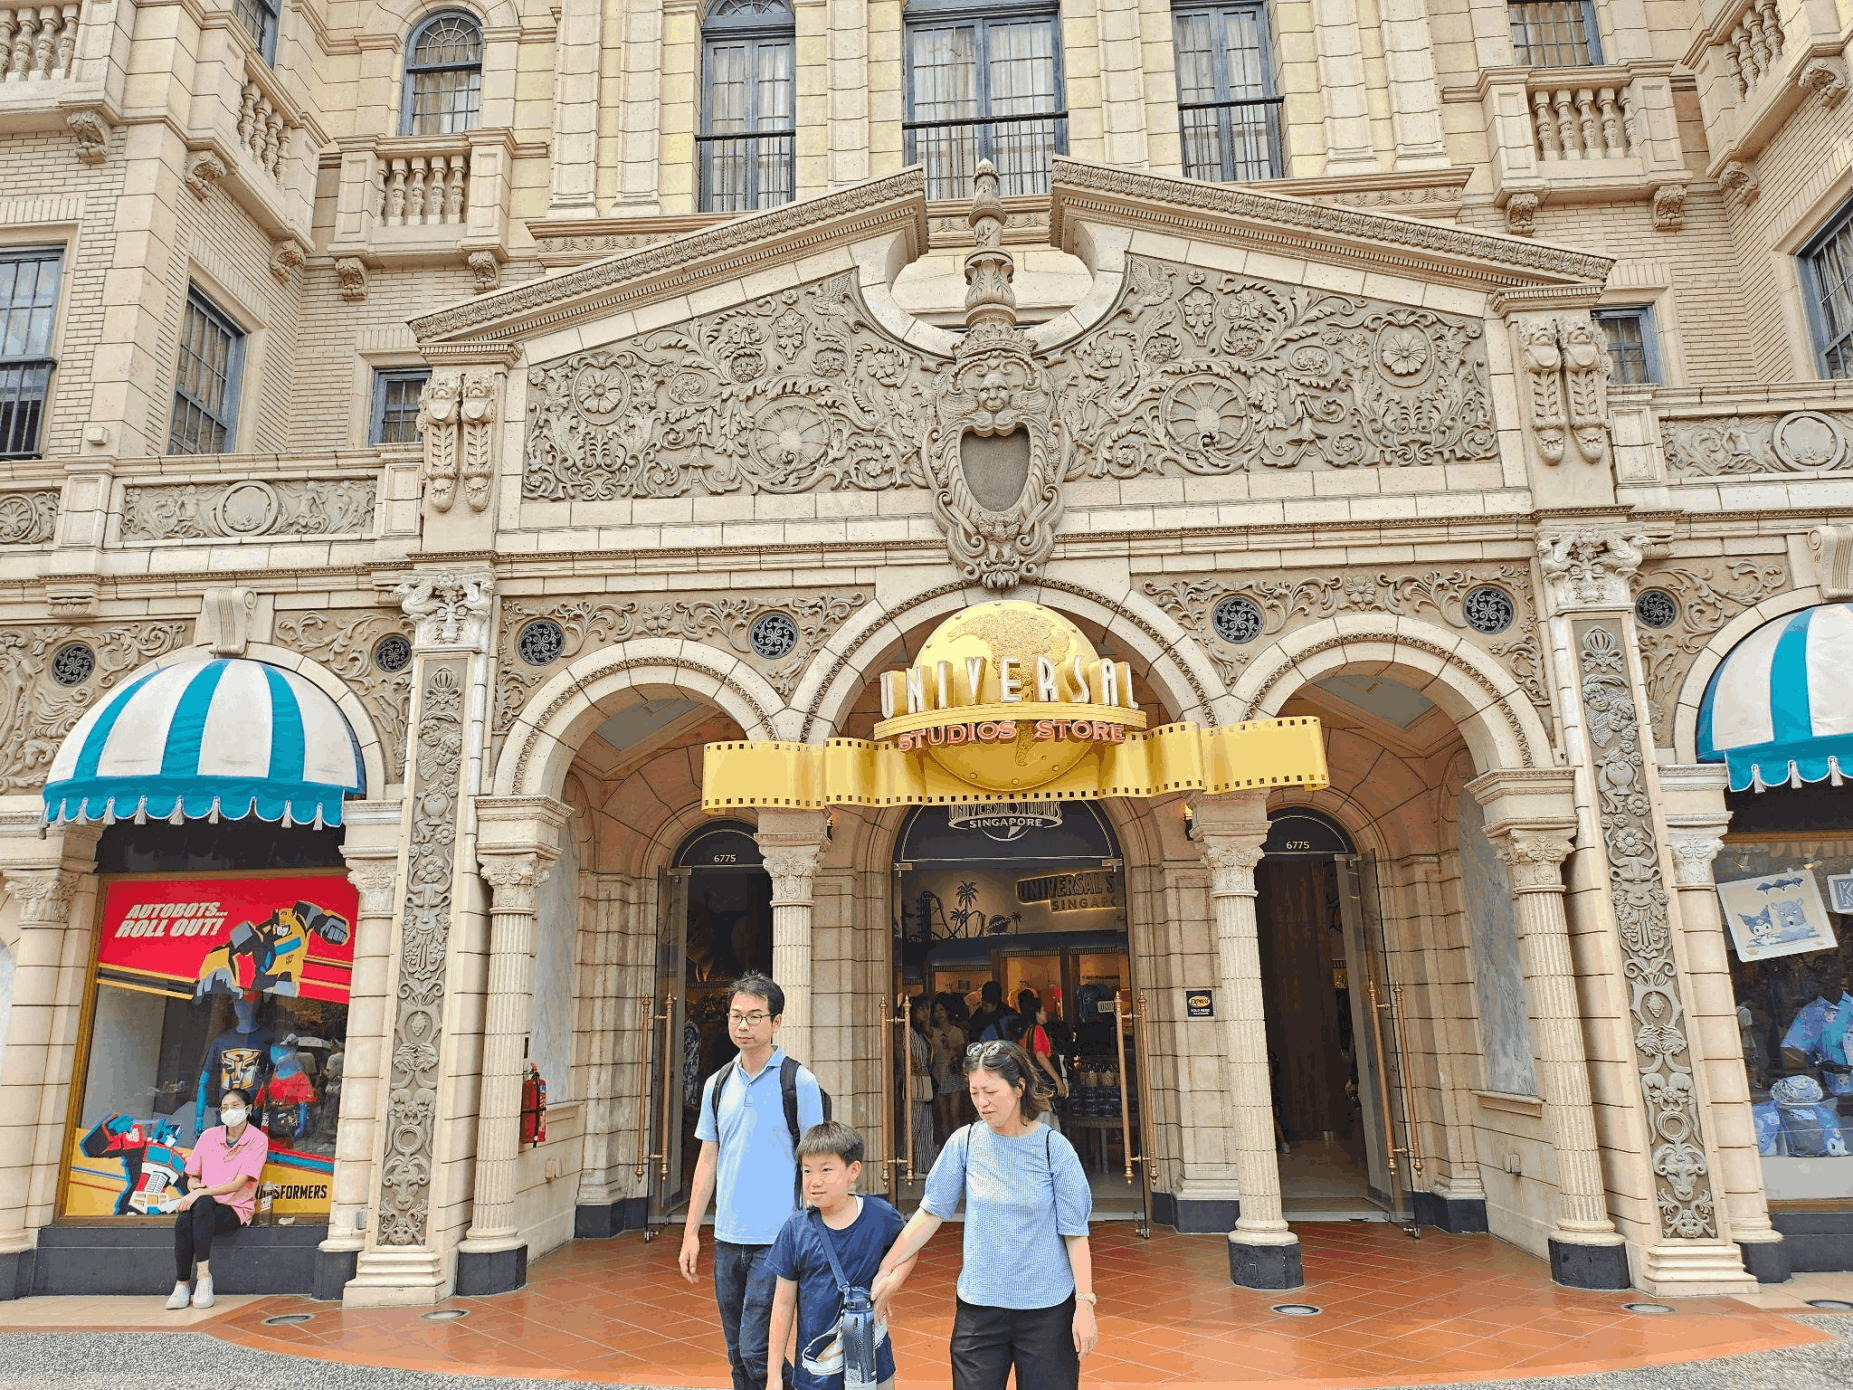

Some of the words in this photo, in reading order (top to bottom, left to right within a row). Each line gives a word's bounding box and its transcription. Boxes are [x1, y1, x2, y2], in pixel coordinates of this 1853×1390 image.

[880, 656, 1139, 720] UNIVERSAL
[897, 720, 1017, 752] STUDIOS
[1032, 719, 1127, 744] STORE
[969, 816, 1043, 830] SINGAPORE
[1286, 840, 1310, 850] 6775
[713, 854, 737, 863] 6775
[1018, 874, 1103, 902] UNIVERSAL
[125, 901, 229, 919] AUTOBOTS...
[114, 919, 168, 938] ROLL
[169, 917, 225, 937] OUT!
